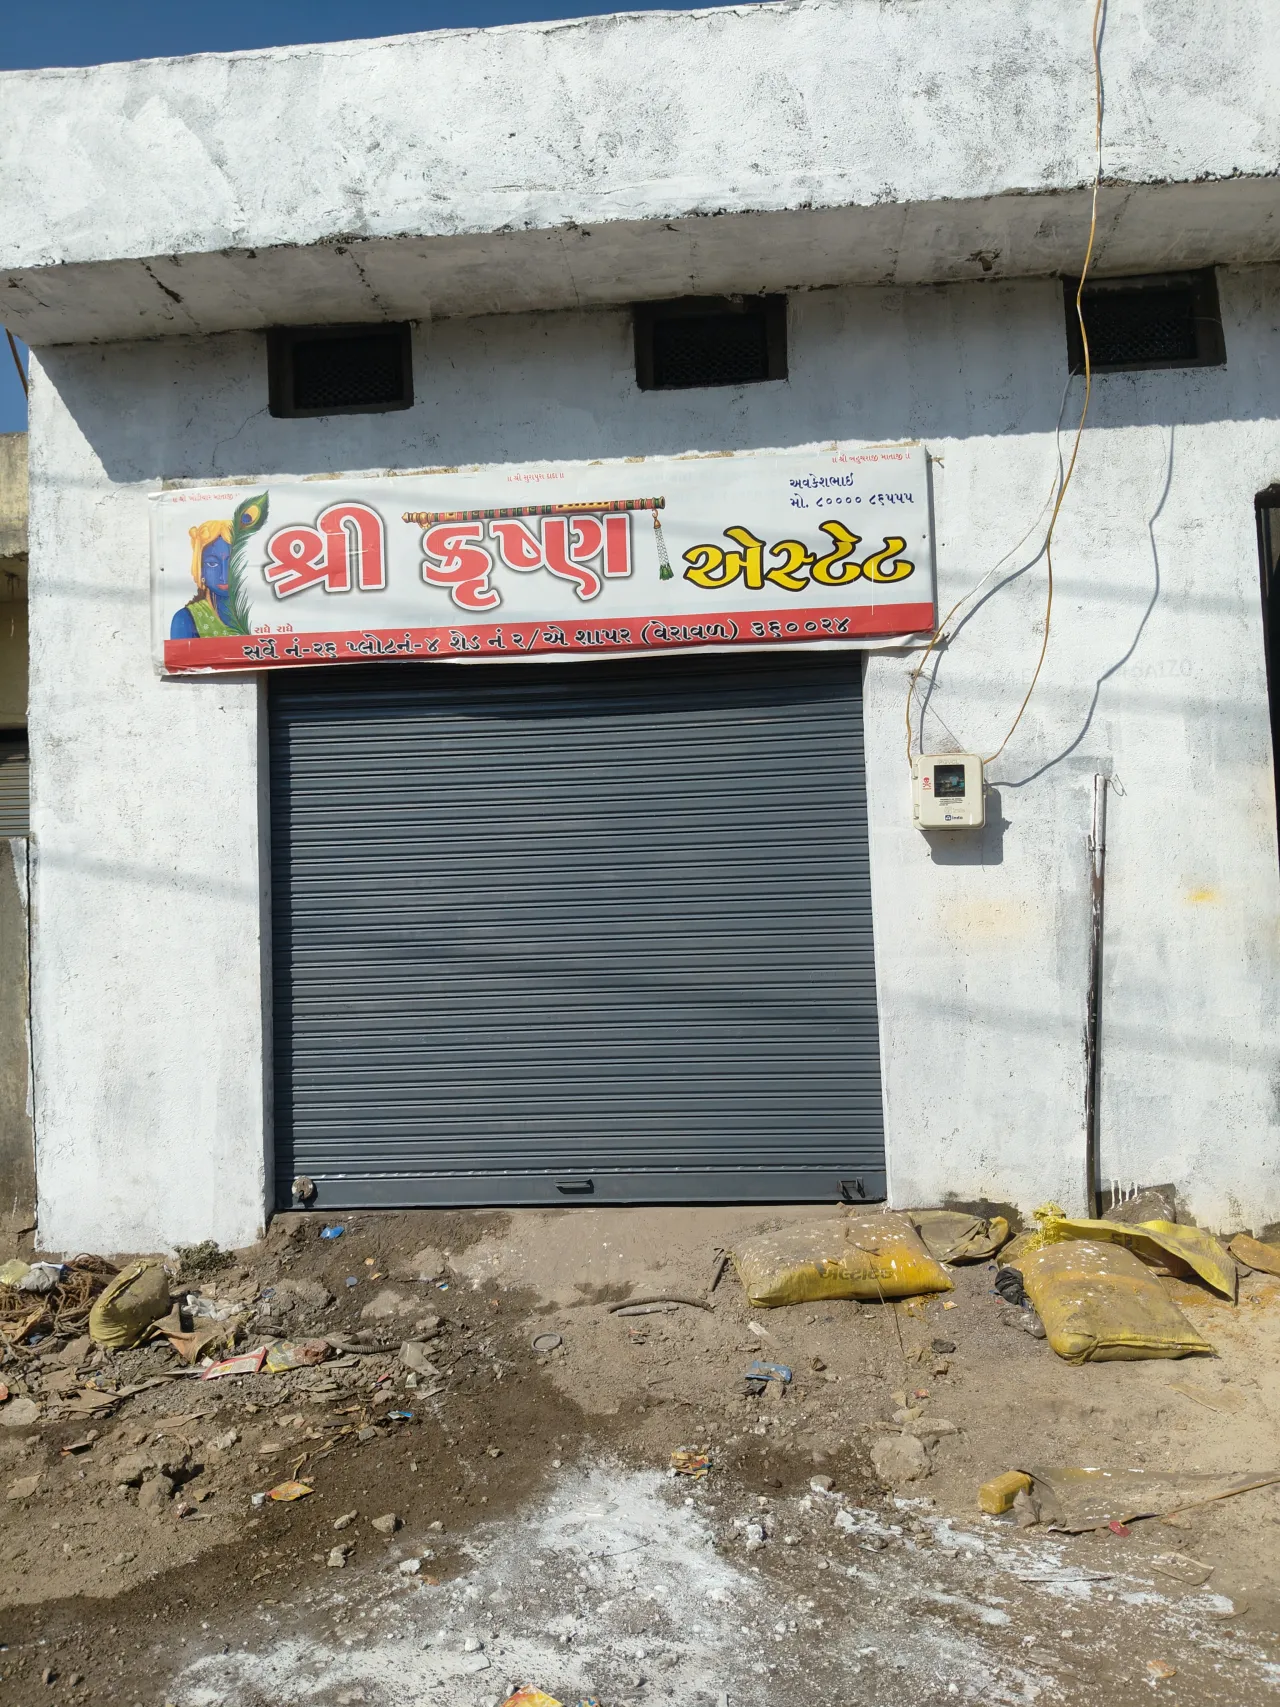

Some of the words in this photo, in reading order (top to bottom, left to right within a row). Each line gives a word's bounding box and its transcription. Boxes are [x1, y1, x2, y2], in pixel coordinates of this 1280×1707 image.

[881, 452, 903, 461] માતાજી
[264, 502, 386, 599] શ્રી
[423, 512, 632, 611] કૃષ્ણ
[682, 519, 916, 593] એસ્ટેટ
[242, 637, 280, 660] સર્વે
[448, 629, 481, 652] શેડ
[487, 627, 507, 649] નં
[574, 628, 633, 645] શાપર
[640, 620, 739, 646] (વેરાવળ)
[751, 616, 851, 638] ૩૬૦૦૨૪
[254, 624, 271, 634] રાધે
[276, 623, 294, 633] રાધે
